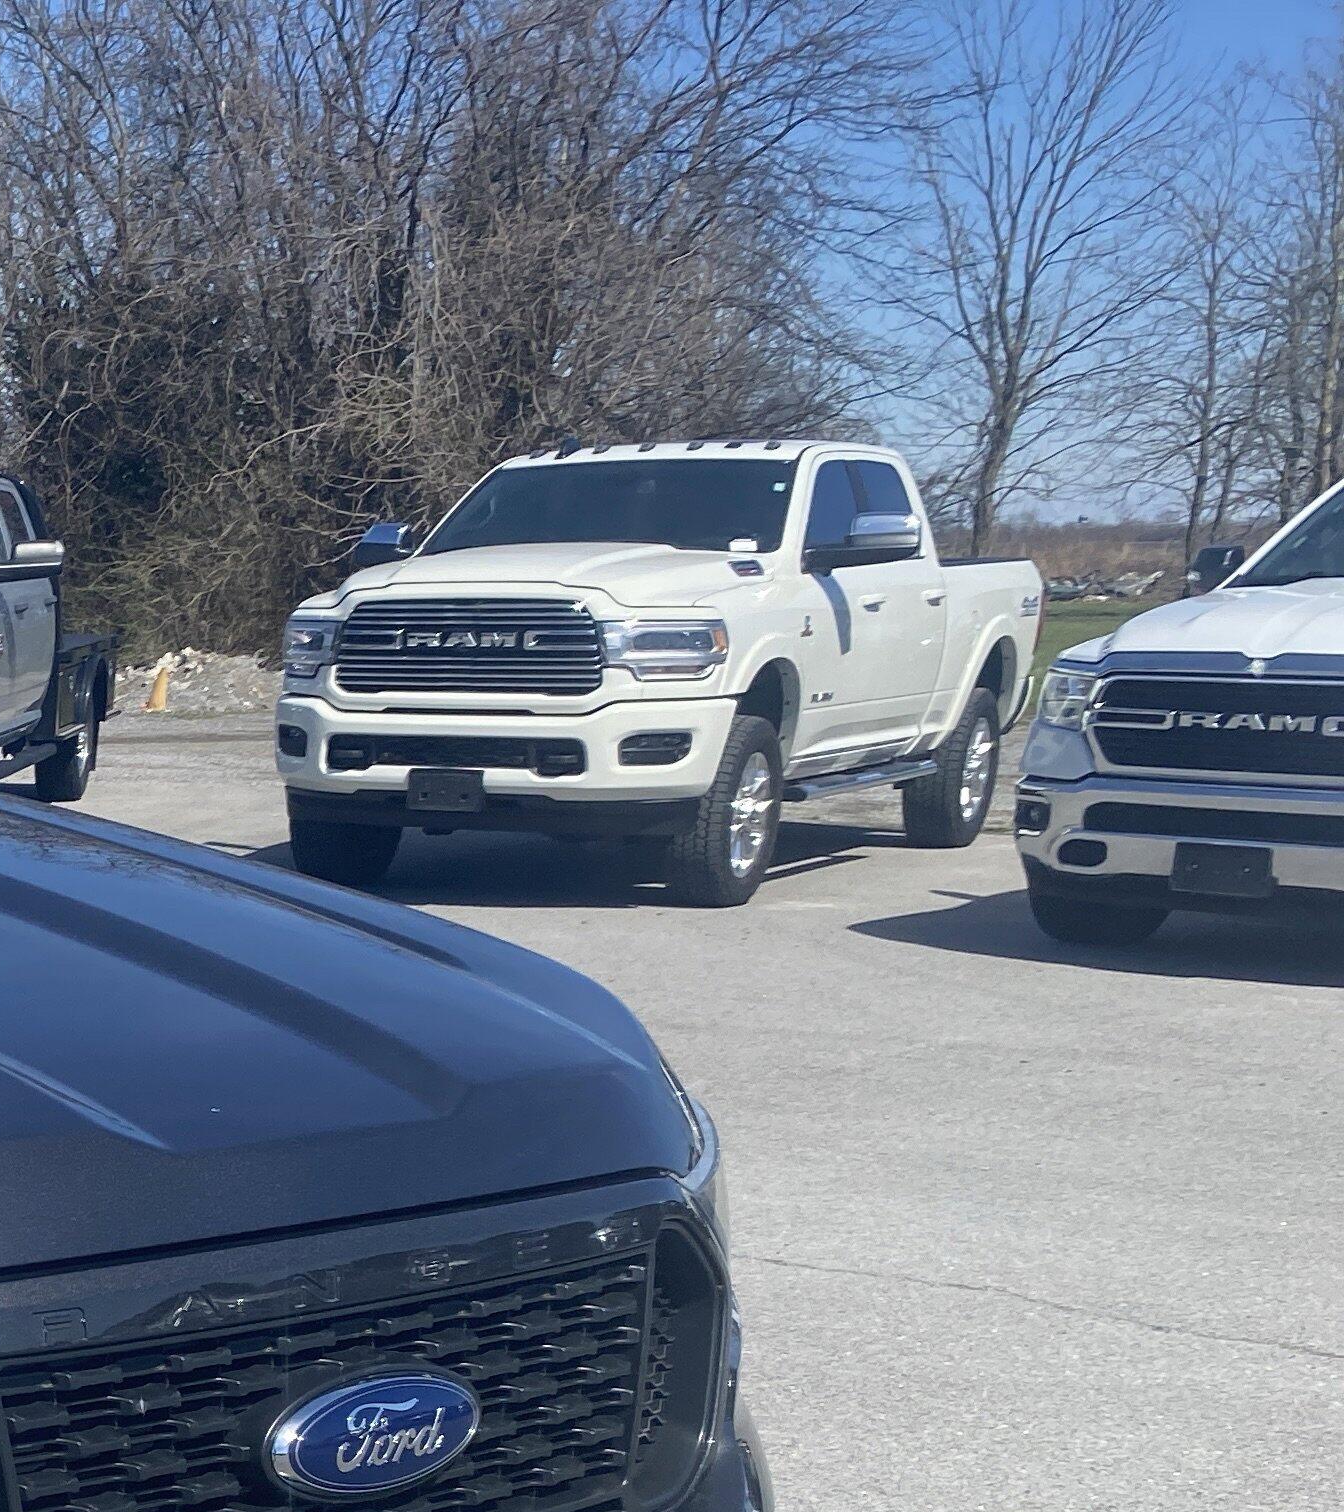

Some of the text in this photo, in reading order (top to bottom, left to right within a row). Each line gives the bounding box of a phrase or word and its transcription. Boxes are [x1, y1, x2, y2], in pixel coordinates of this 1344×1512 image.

[406, 632, 518, 648] RAM
[1178, 710, 1317, 732] RAM
[336, 1397, 447, 1473] Ford
